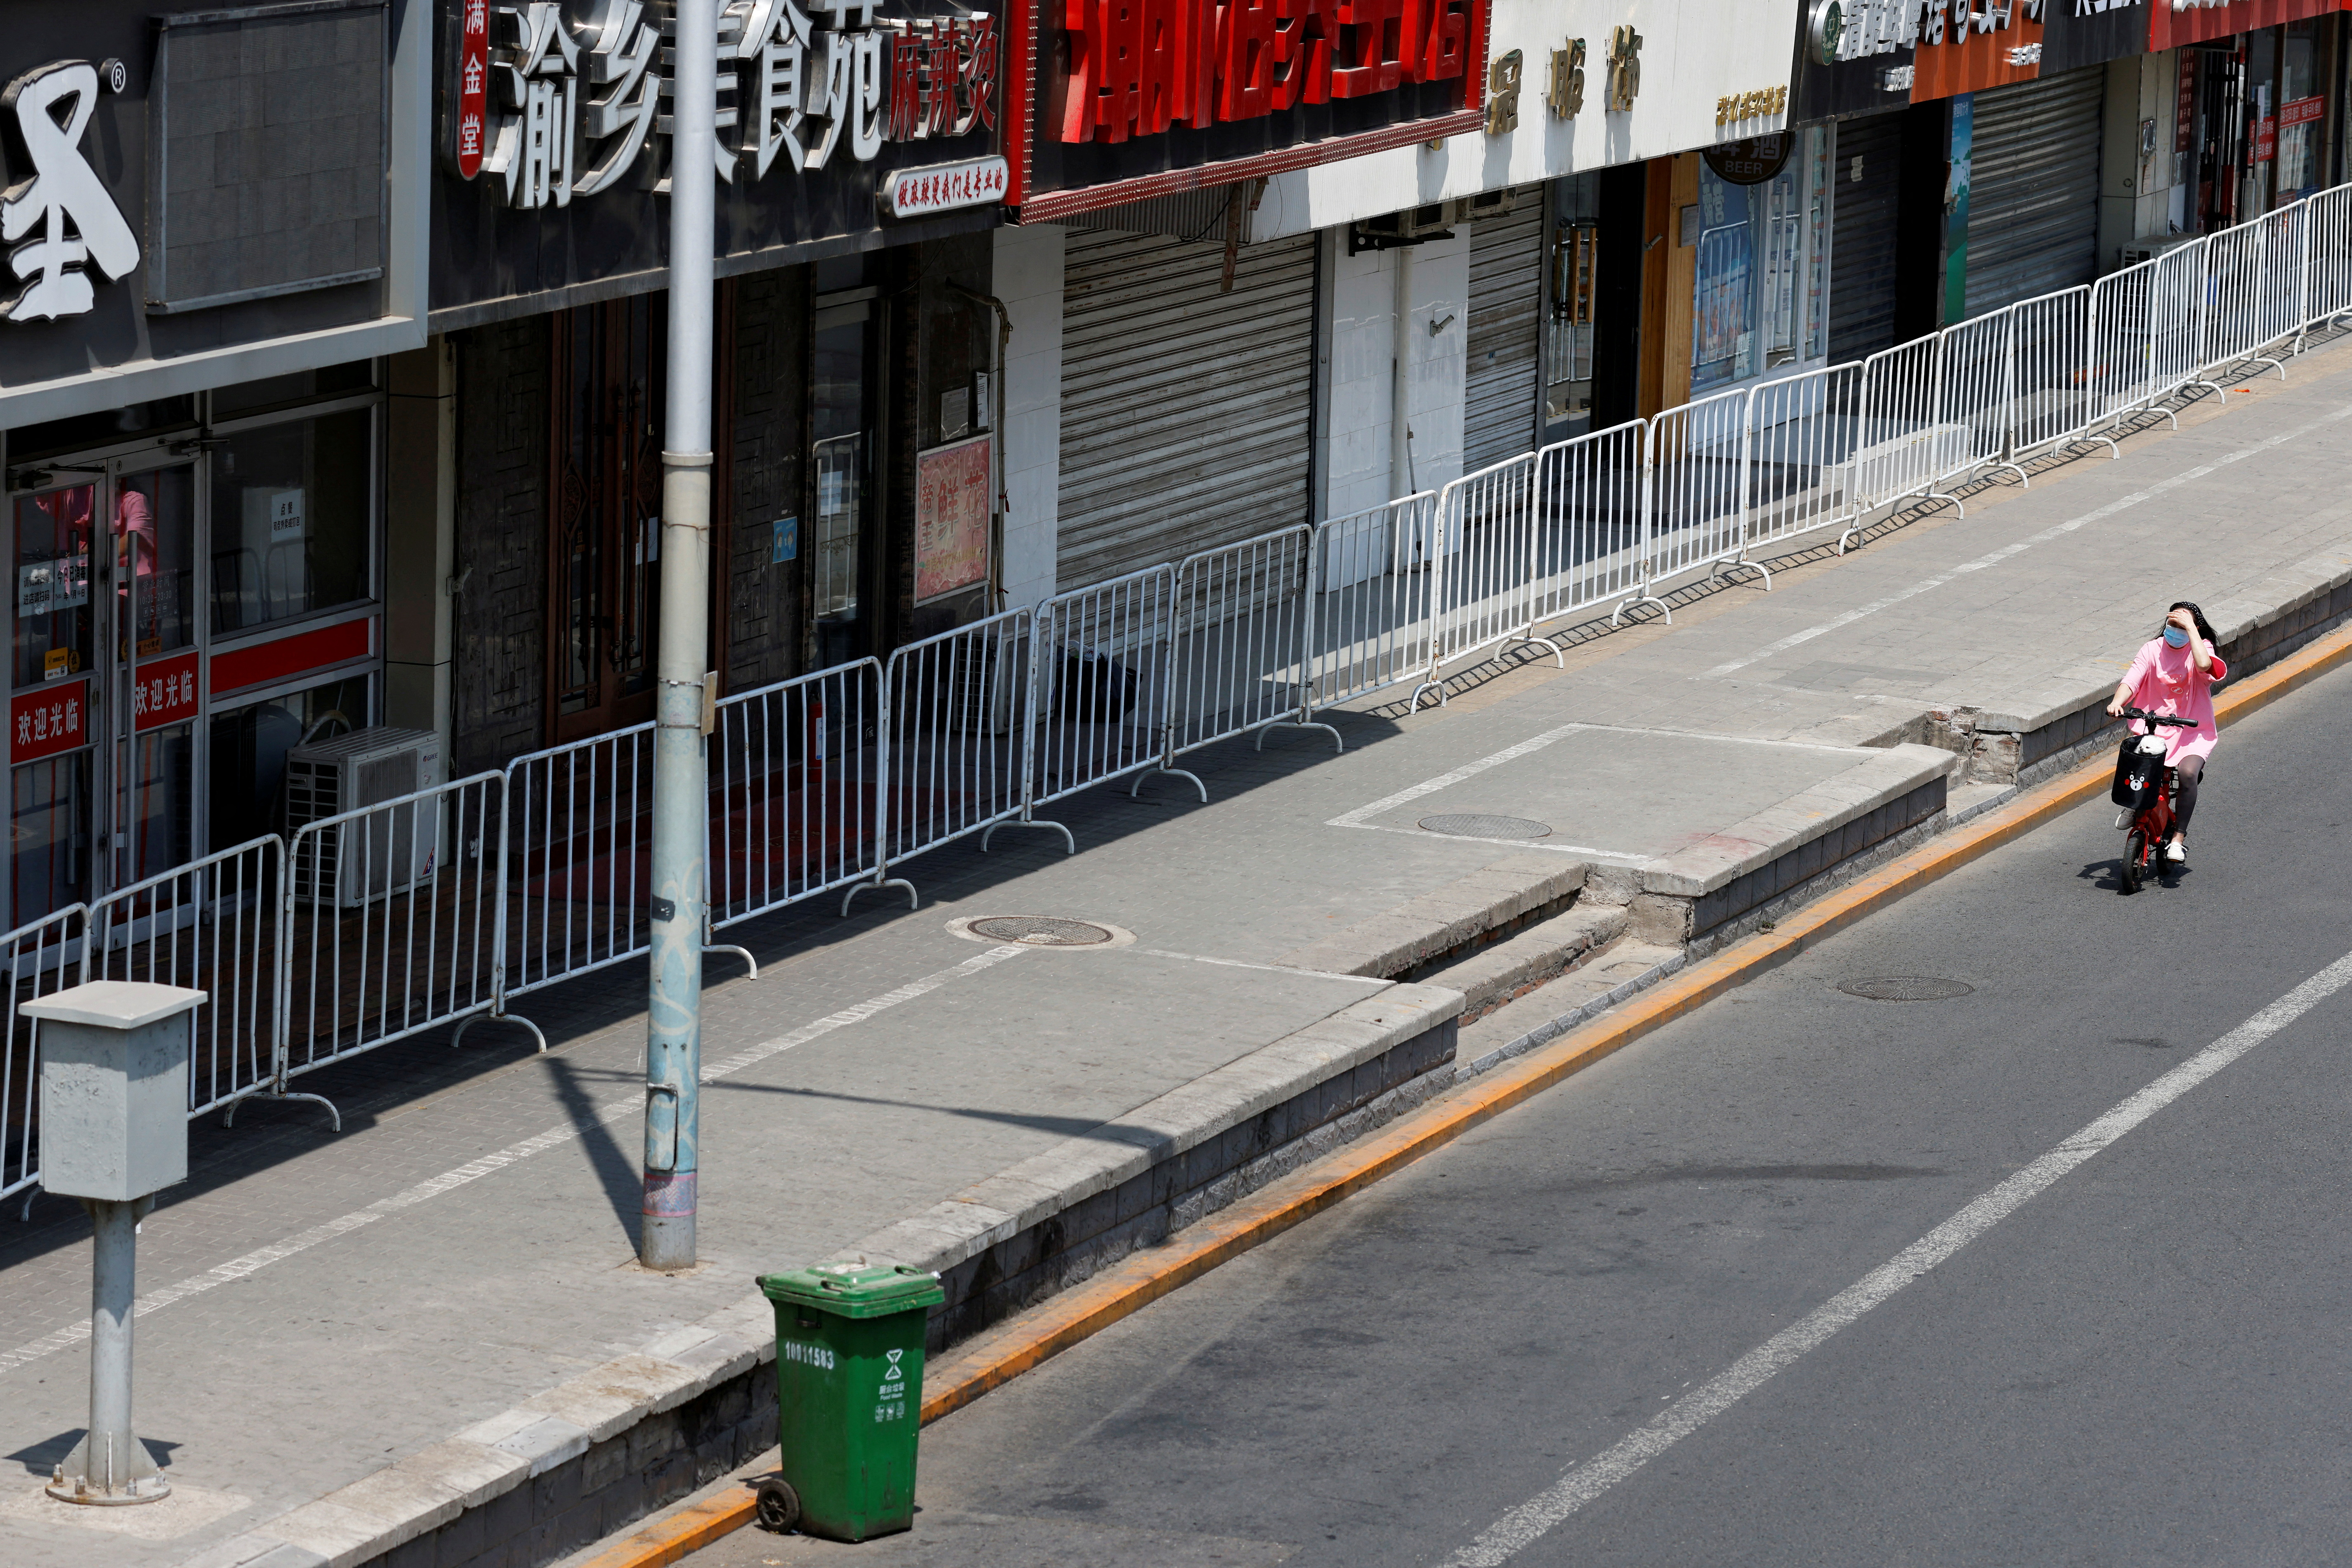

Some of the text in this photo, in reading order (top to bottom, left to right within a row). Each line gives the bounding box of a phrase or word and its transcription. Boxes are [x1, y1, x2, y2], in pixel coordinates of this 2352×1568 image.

[462, 1, 486, 156] 满金堂
[889, 12, 998, 142] 麻辣烫
[1725, 161, 1762, 175] BEER
[898, 165, 1002, 209] 做麻辣烫我们是专业的
[281, 502, 293, 516] 点餐
[922, 481, 933, 550] 帝王
[937, 469, 984, 539] 鲜花
[274, 516, 300, 531] 可点外卖或打包
[58, 562, 86, 585] 今日已消毒
[143, 576, 170, 592] 营业时间
[24, 590, 50, 605] 进店请扫码
[140, 590, 172, 605] 10:30-23:30
[135, 670, 193, 716] 欢迎光临
[18, 698, 78, 746] 欢迎光临
[427, 752, 438, 761] GREE
[786, 1342, 834, 1370] 10011583
[879, 1382, 905, 1395] 厨余垃圾
